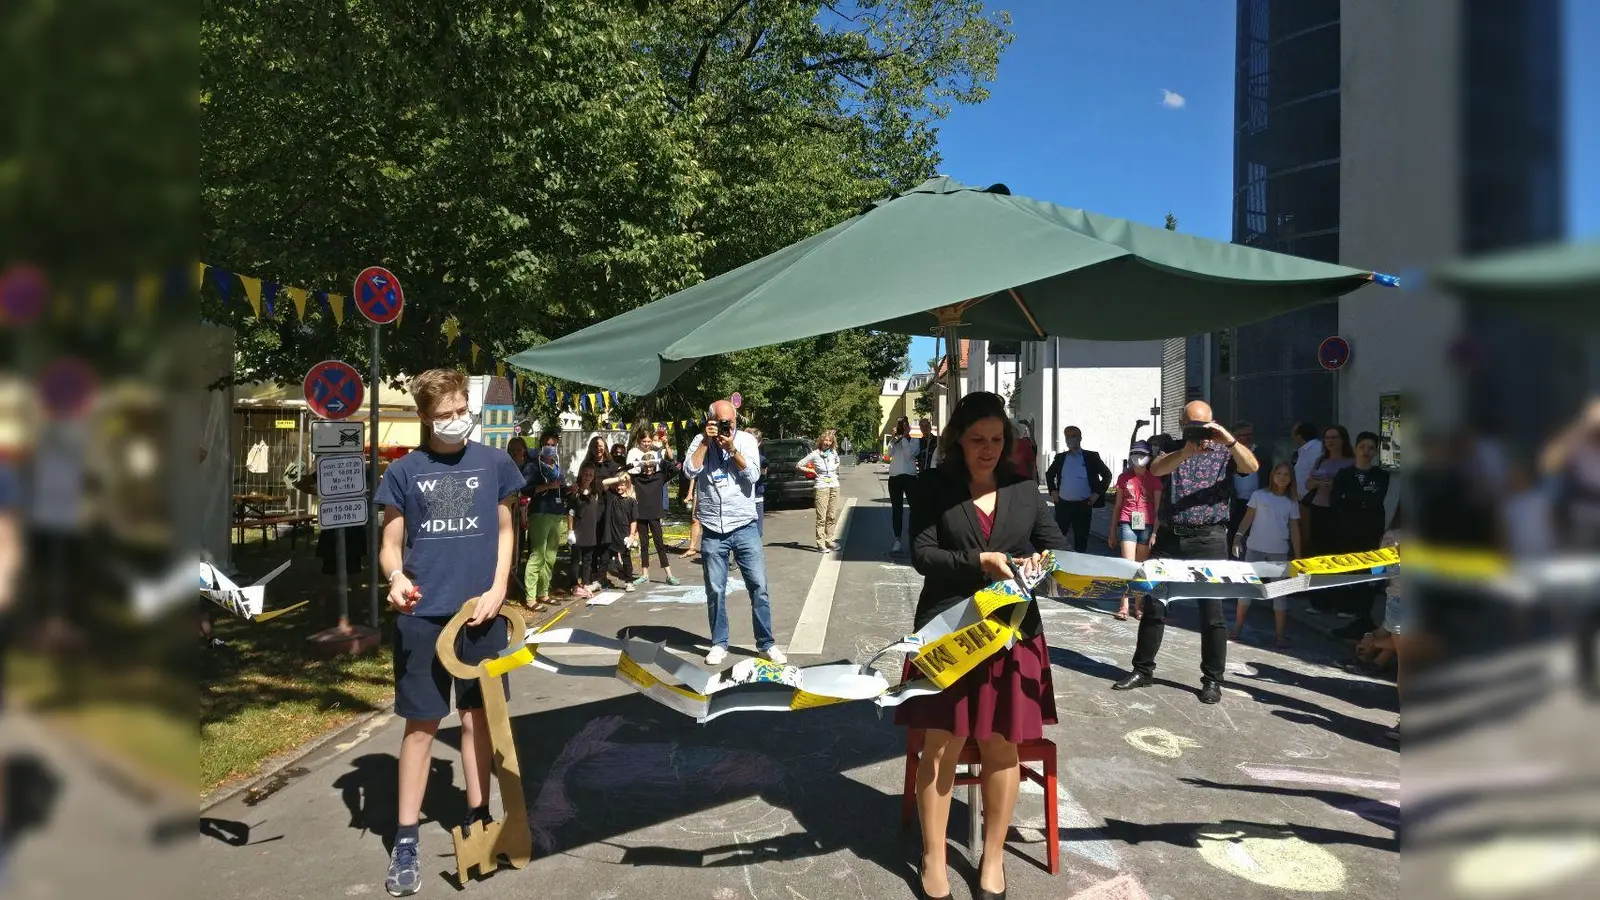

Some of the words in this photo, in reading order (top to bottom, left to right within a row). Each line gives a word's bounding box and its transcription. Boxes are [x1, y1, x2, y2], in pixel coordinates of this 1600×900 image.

[416, 479, 437, 493] W
[465, 476, 479, 489] G
[334, 503, 362, 513] 15.08.20
[418, 516, 479, 532] MDLIX
